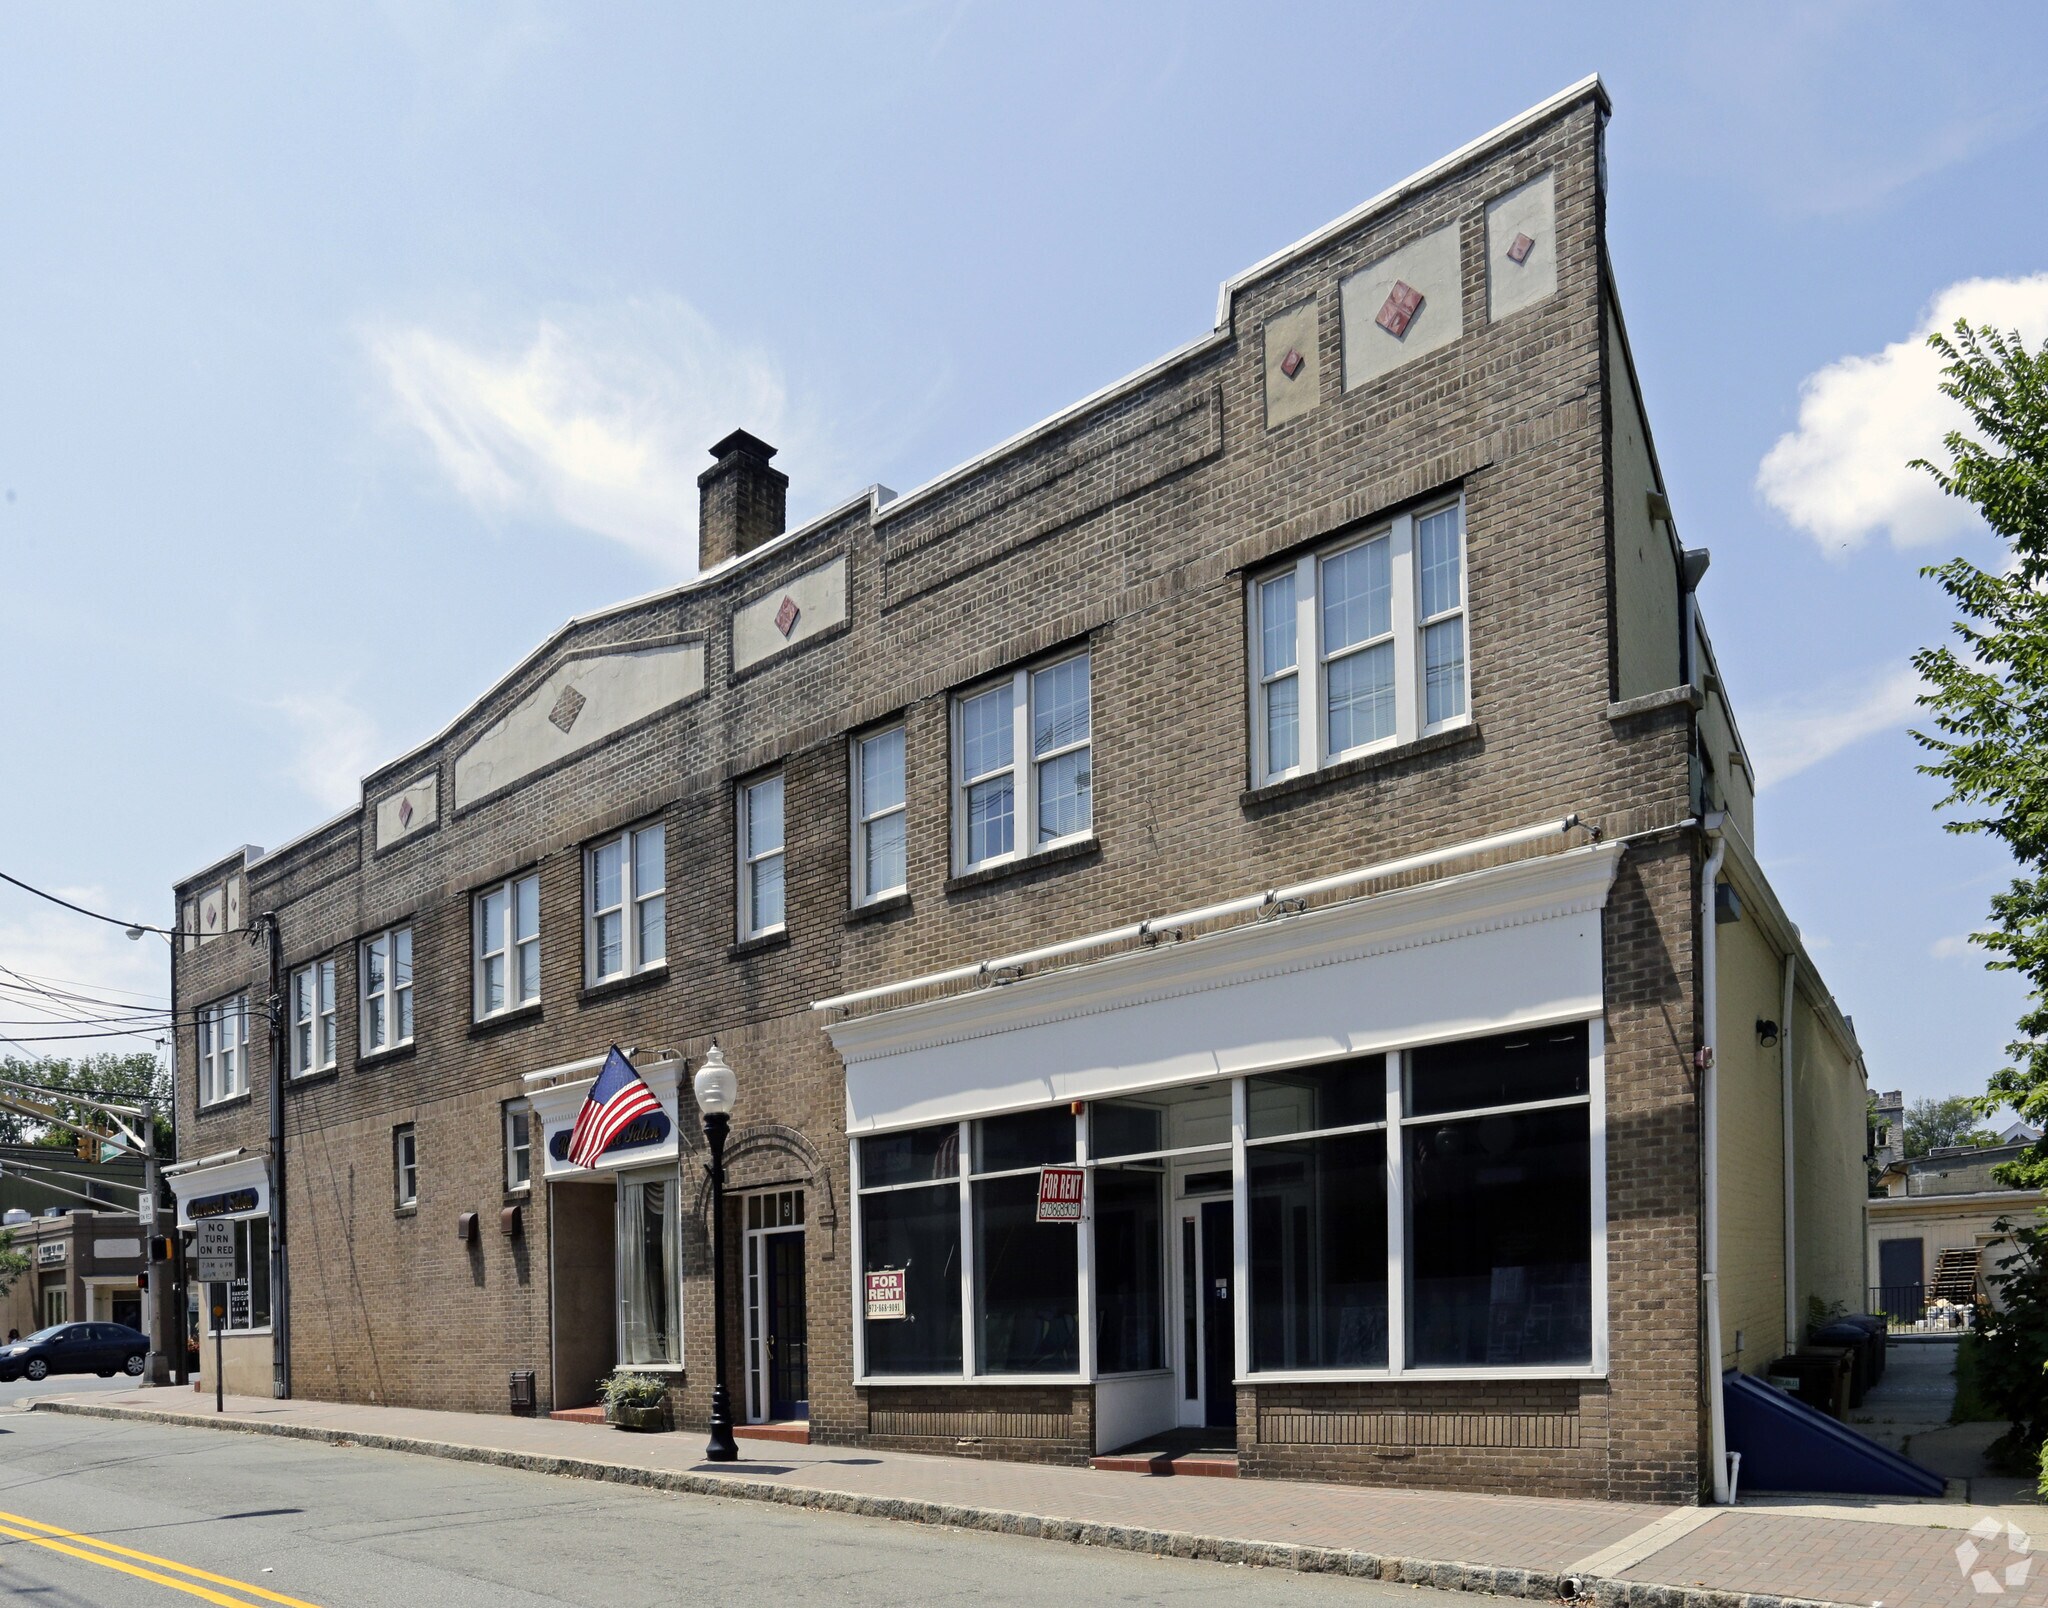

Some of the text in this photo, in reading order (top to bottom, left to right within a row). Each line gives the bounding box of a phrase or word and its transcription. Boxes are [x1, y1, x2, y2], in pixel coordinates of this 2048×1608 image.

[624, 1120, 659, 1144] Salon
[1042, 1173, 1082, 1200] FOR RENT
[208, 1223, 224, 1232] NO
[204, 1234, 229, 1243] TURN
[199, 1245, 234, 1255] ON RED
[231, 1277, 249, 1287] NAIL
[871, 1275, 898, 1288] FOR
[868, 1287, 902, 1301] RENT
